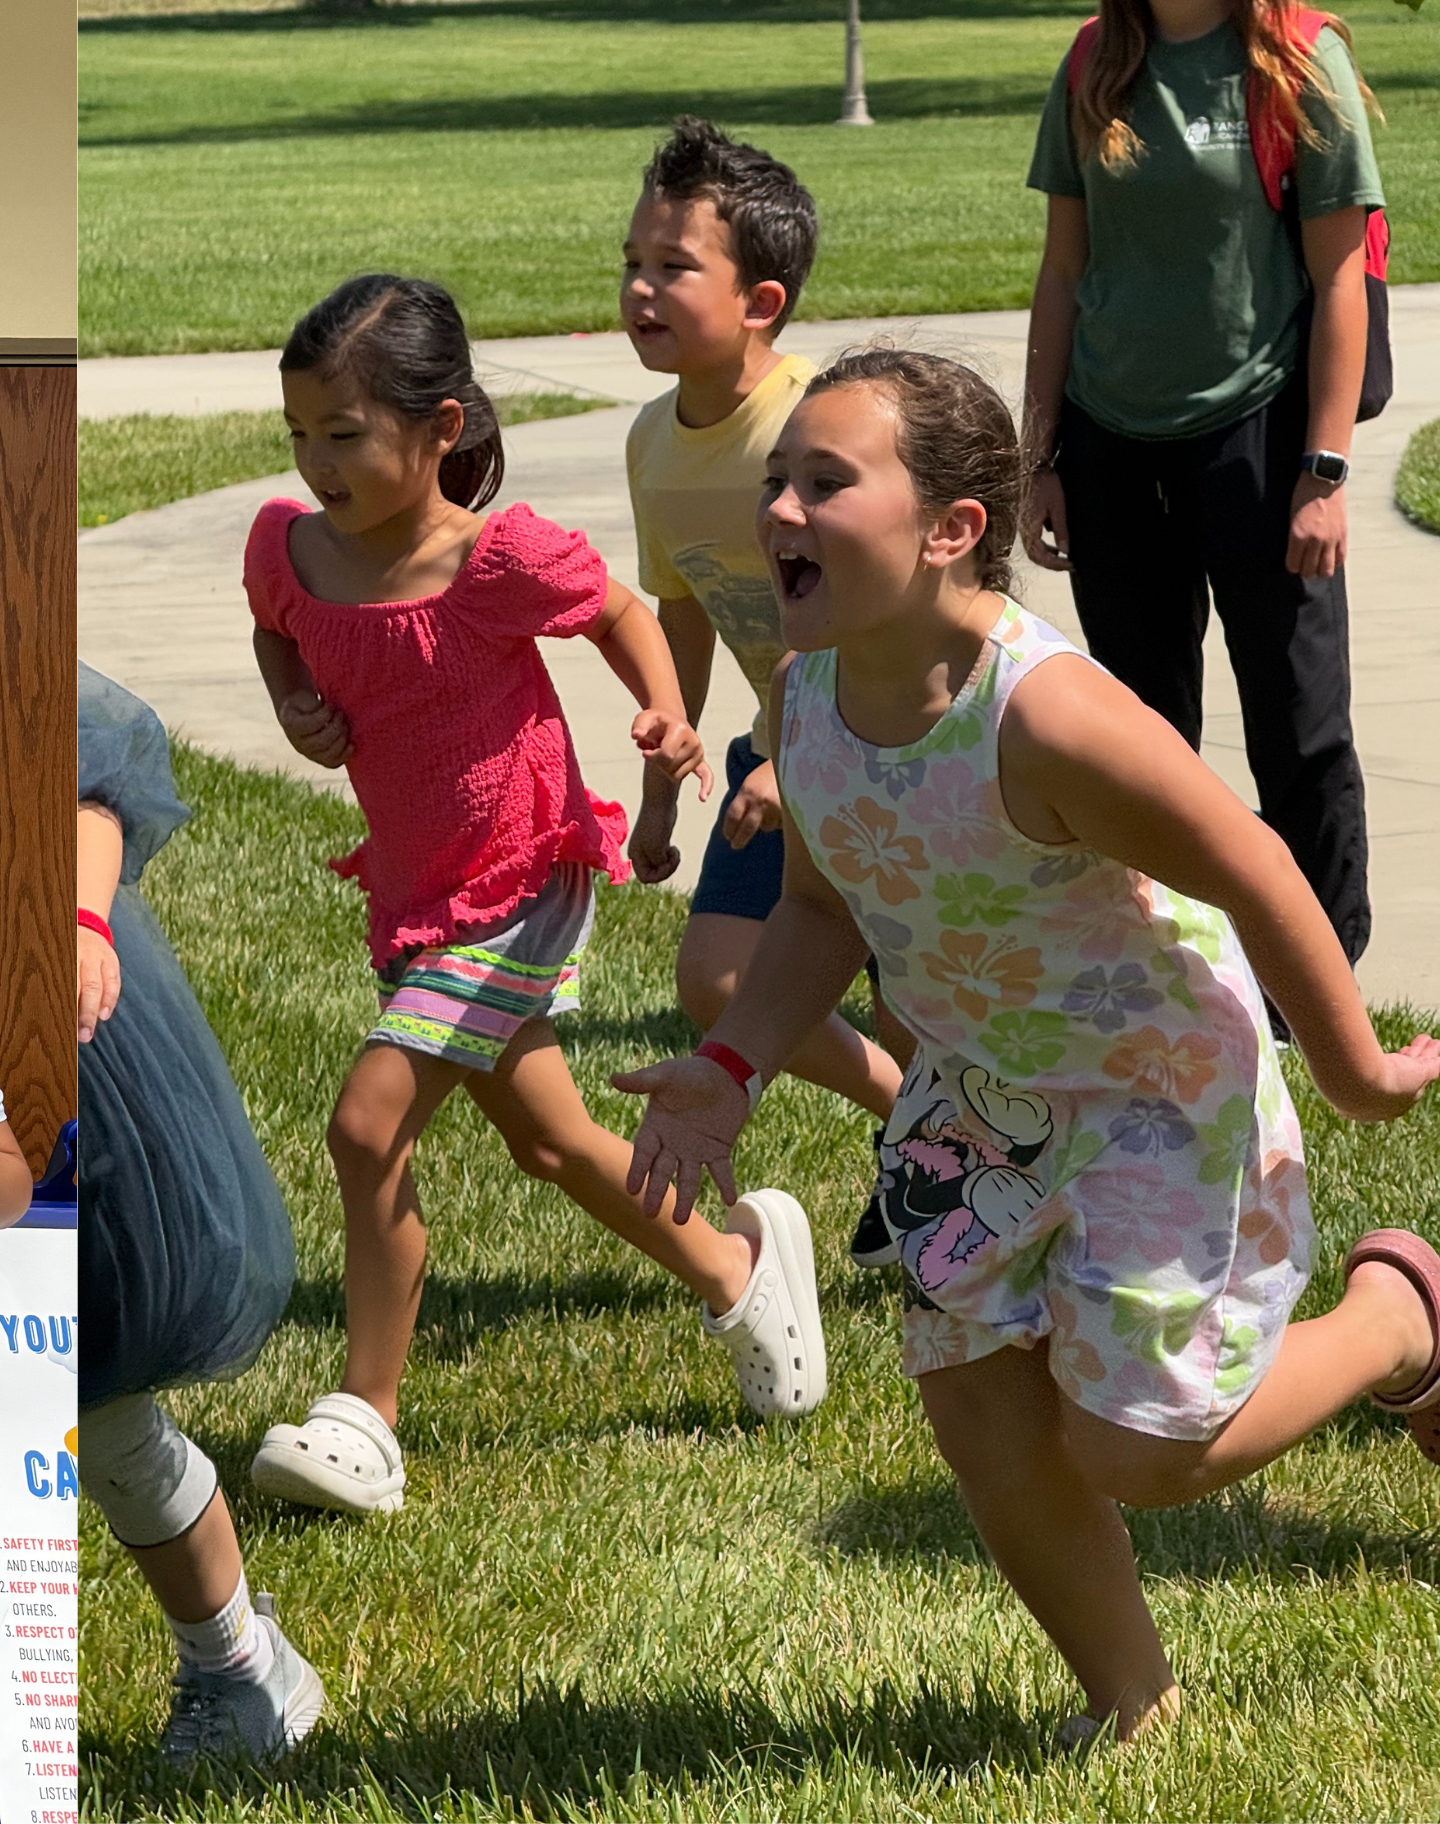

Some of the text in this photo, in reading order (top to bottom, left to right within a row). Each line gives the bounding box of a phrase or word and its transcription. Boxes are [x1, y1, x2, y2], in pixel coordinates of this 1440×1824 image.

[7, 1559, 78, 1573] AND ENJOYAB
[40, 1582, 70, 1595] YOUR
[12, 1603, 57, 1617] OTHERS.
[19, 1647, 73, 1662] BULLYING,
[40, 1671, 78, 1684] ELECT
[30, 1717, 51, 1730] AND
[67, 1741, 75, 1754] A
[39, 1787, 78, 1800] LISTEN
